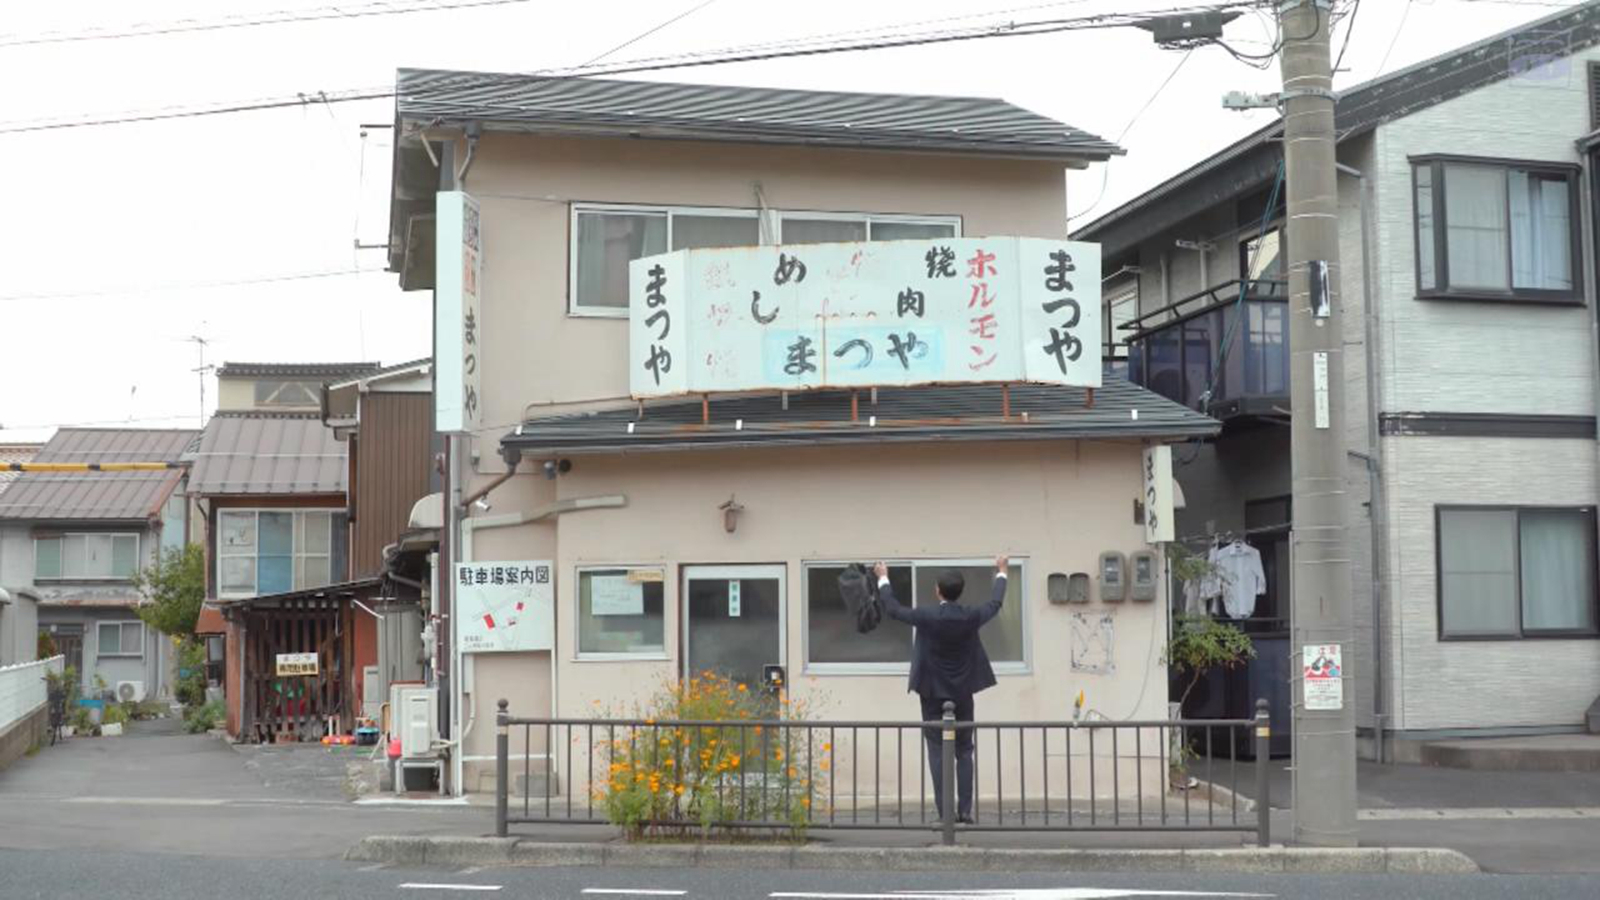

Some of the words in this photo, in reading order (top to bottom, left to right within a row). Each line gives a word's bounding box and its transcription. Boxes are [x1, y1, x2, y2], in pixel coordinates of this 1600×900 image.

[464, 307, 478, 421] まつや
[643, 264, 672, 386] まつや
[783, 332, 929, 377] まつや
[965, 249, 998, 371] ホルモン
[1042, 250, 1083, 376] まつや
[1146, 455, 1157, 536] まつや
[459, 564, 549, 586] 駐車場案内図
